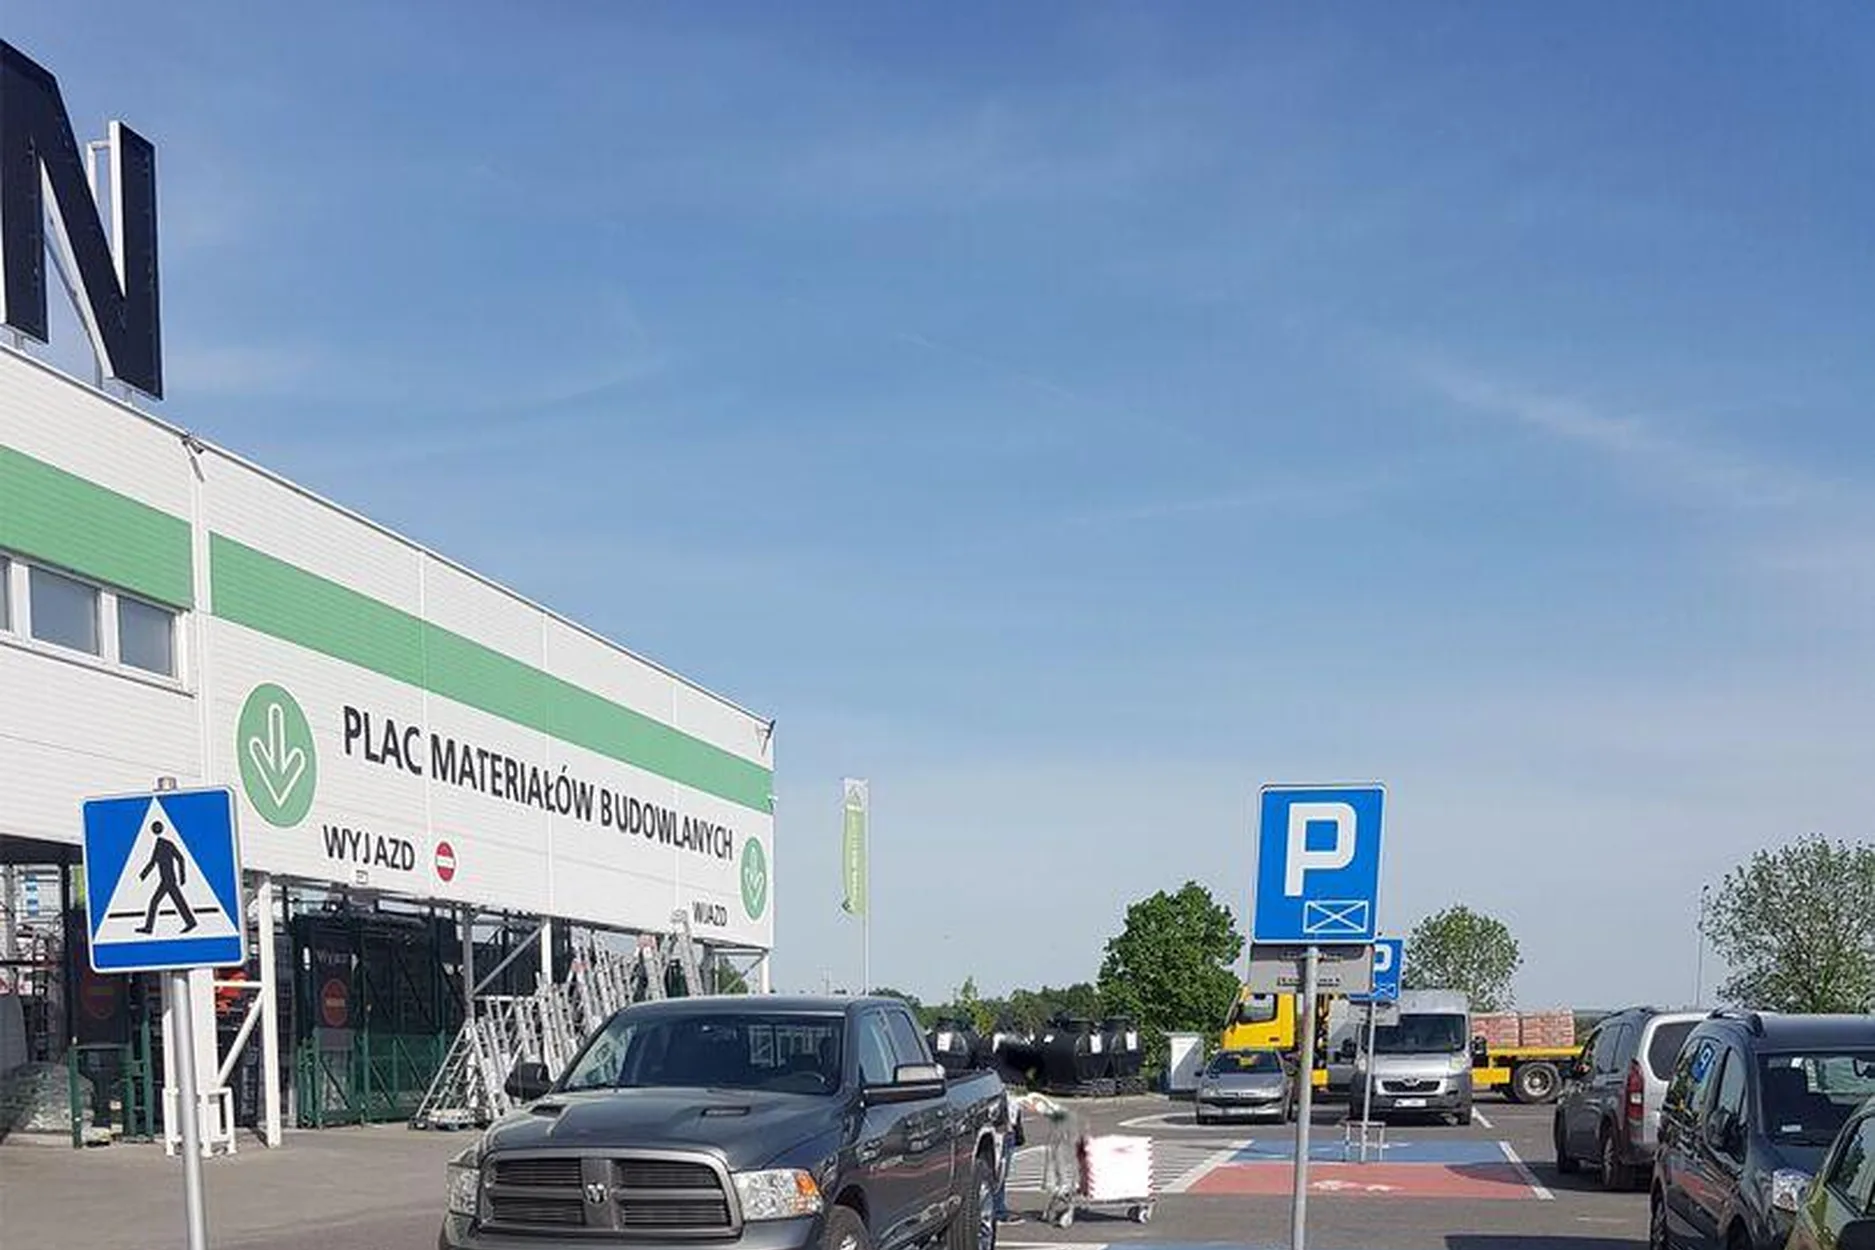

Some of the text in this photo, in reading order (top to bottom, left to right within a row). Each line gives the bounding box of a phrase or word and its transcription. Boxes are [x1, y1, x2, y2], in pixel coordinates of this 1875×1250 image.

[344, 706, 733, 860] PLAC MATERIAŁÓW BUDOWLANYCH
[323, 824, 415, 871] WYJAZD
[1284, 803, 1357, 897] P
